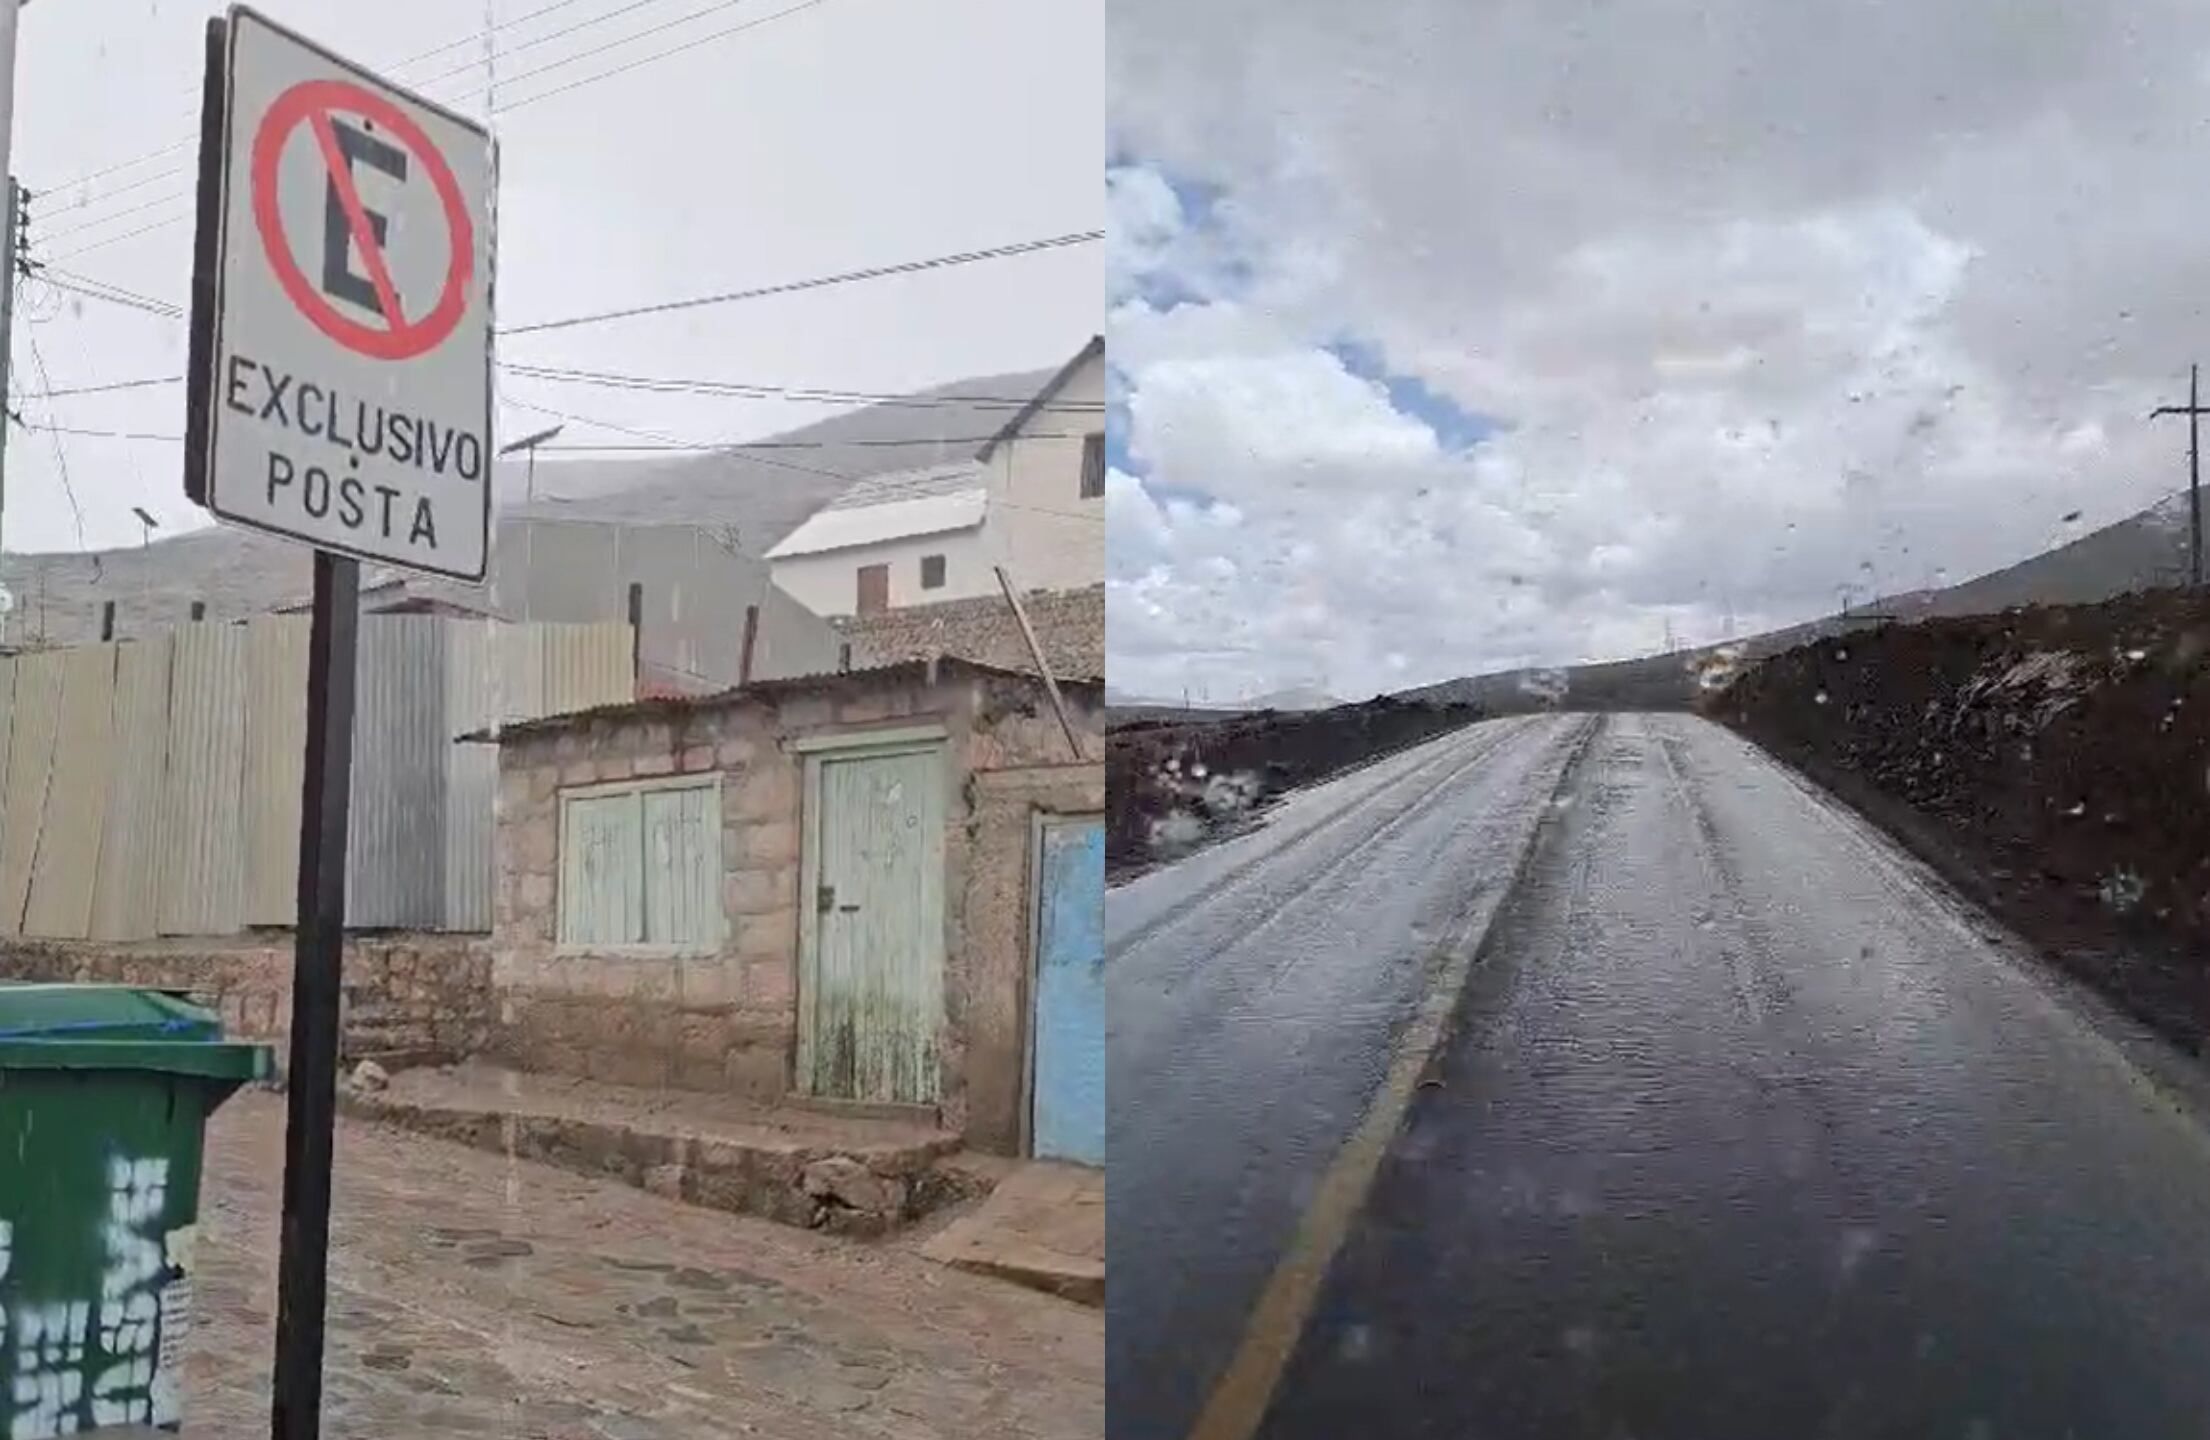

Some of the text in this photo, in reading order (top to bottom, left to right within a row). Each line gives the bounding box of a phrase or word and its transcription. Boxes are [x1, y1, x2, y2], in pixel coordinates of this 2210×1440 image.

[322, 115, 407, 317] E
[227, 355, 481, 480] EXCLUSIVO
[266, 451, 437, 549] POSTA
